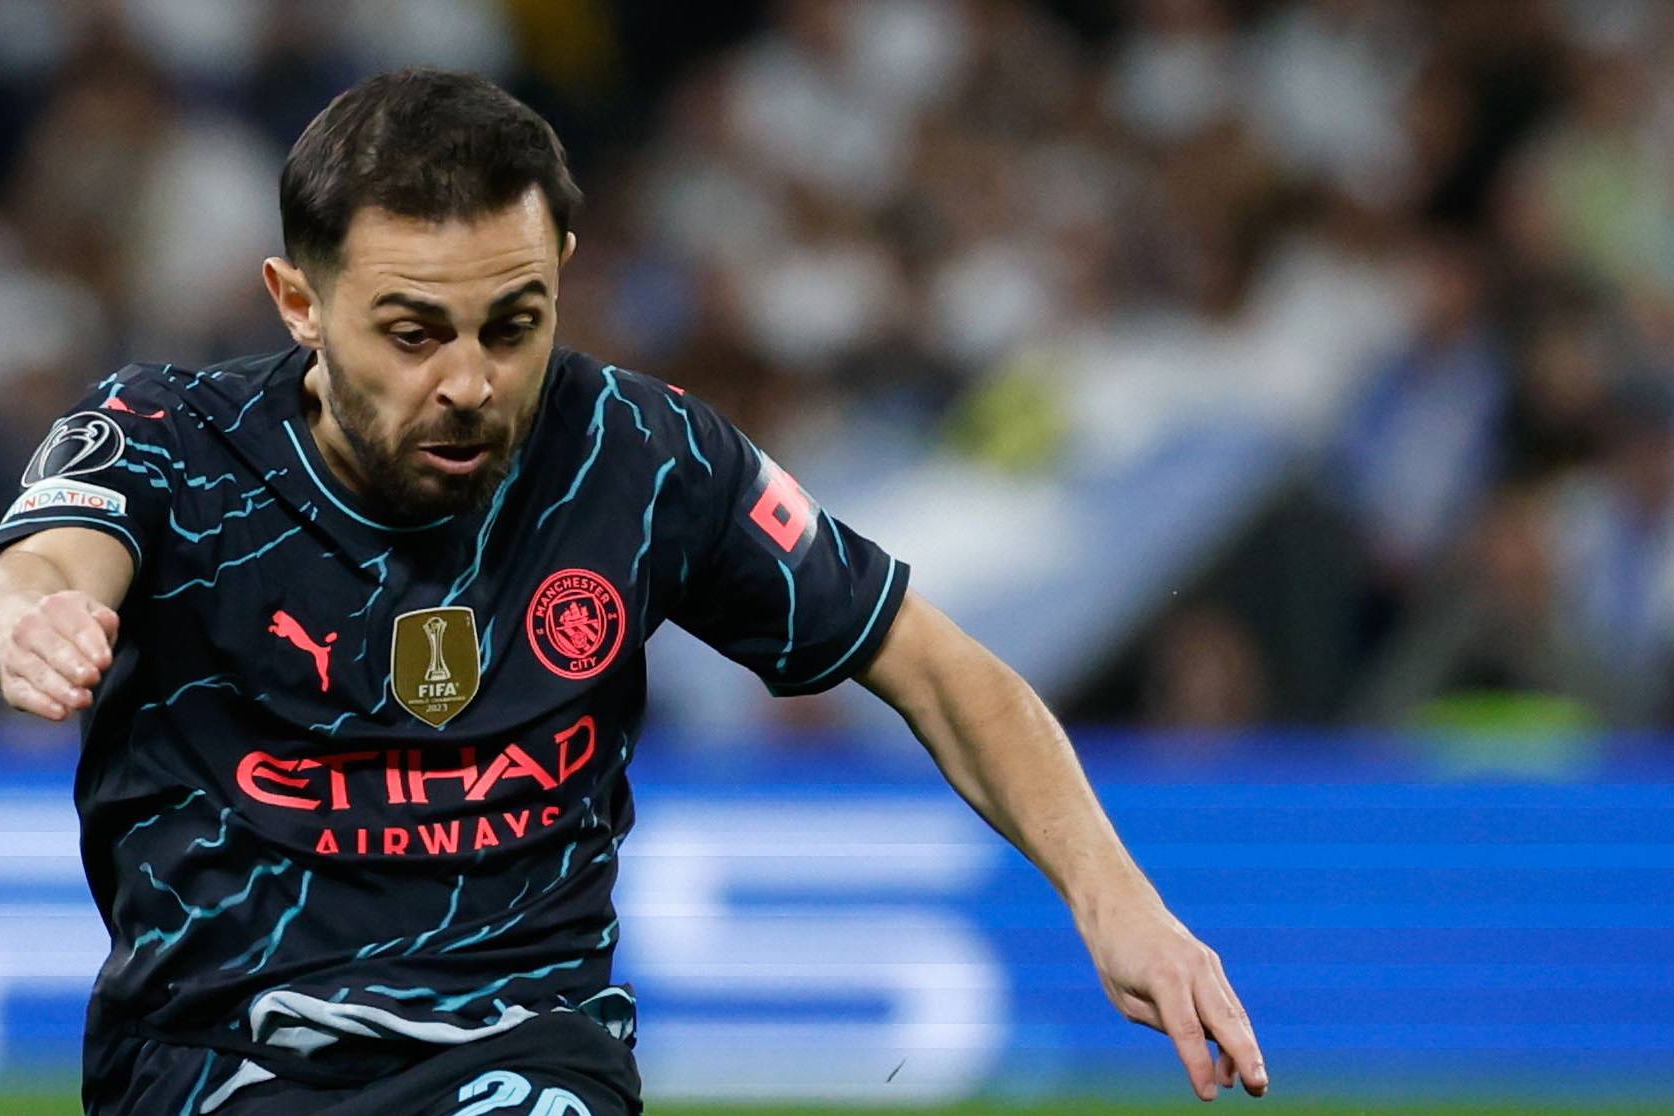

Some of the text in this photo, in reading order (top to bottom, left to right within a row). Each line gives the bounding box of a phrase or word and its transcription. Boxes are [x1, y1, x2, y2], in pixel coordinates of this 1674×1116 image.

[535, 577, 610, 617] MANCHESTER
[569, 657, 597, 671] CITY
[418, 682, 457, 698] FIFA
[236, 715, 596, 810] ETIHAD
[315, 806, 562, 855] AIRWAYS
